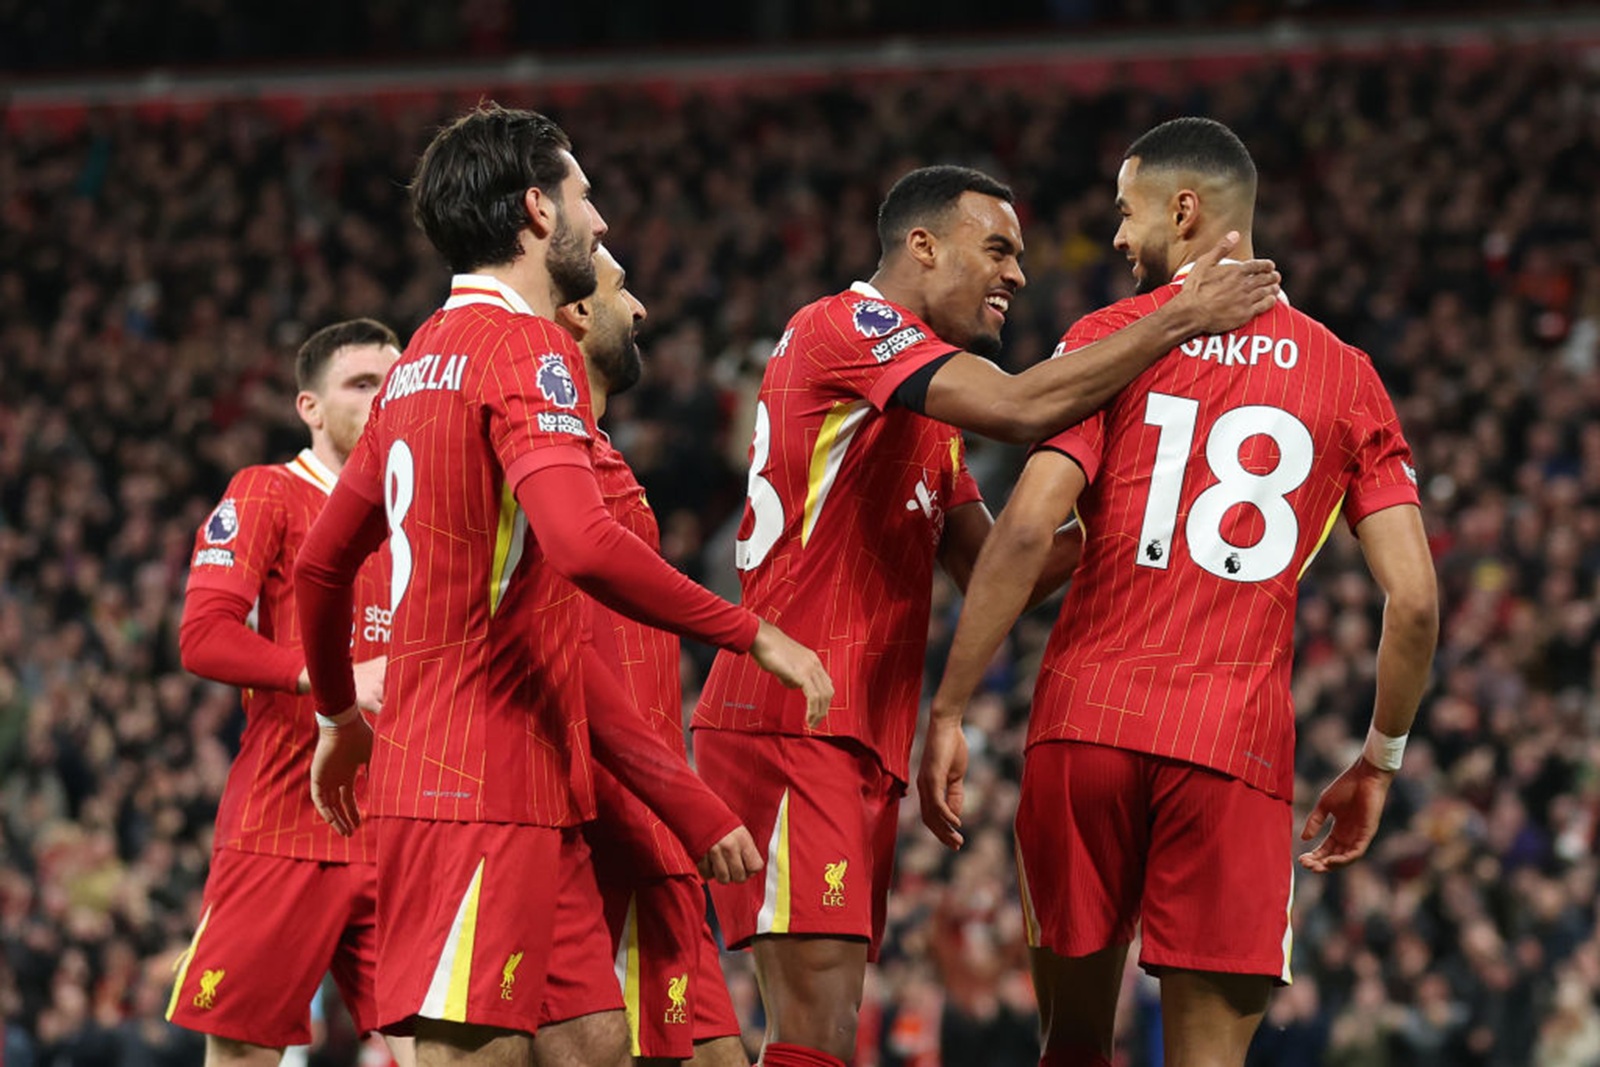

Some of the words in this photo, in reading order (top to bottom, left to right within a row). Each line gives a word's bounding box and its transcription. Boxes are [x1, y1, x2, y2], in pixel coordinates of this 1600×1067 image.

[871, 342, 889, 358] No
[887, 327, 918, 347] room
[1180, 333, 1299, 370] GAKPO
[381, 354, 468, 410] OBOSZLAI
[1136, 391, 1315, 583] 18
[385, 439, 415, 616] 8
